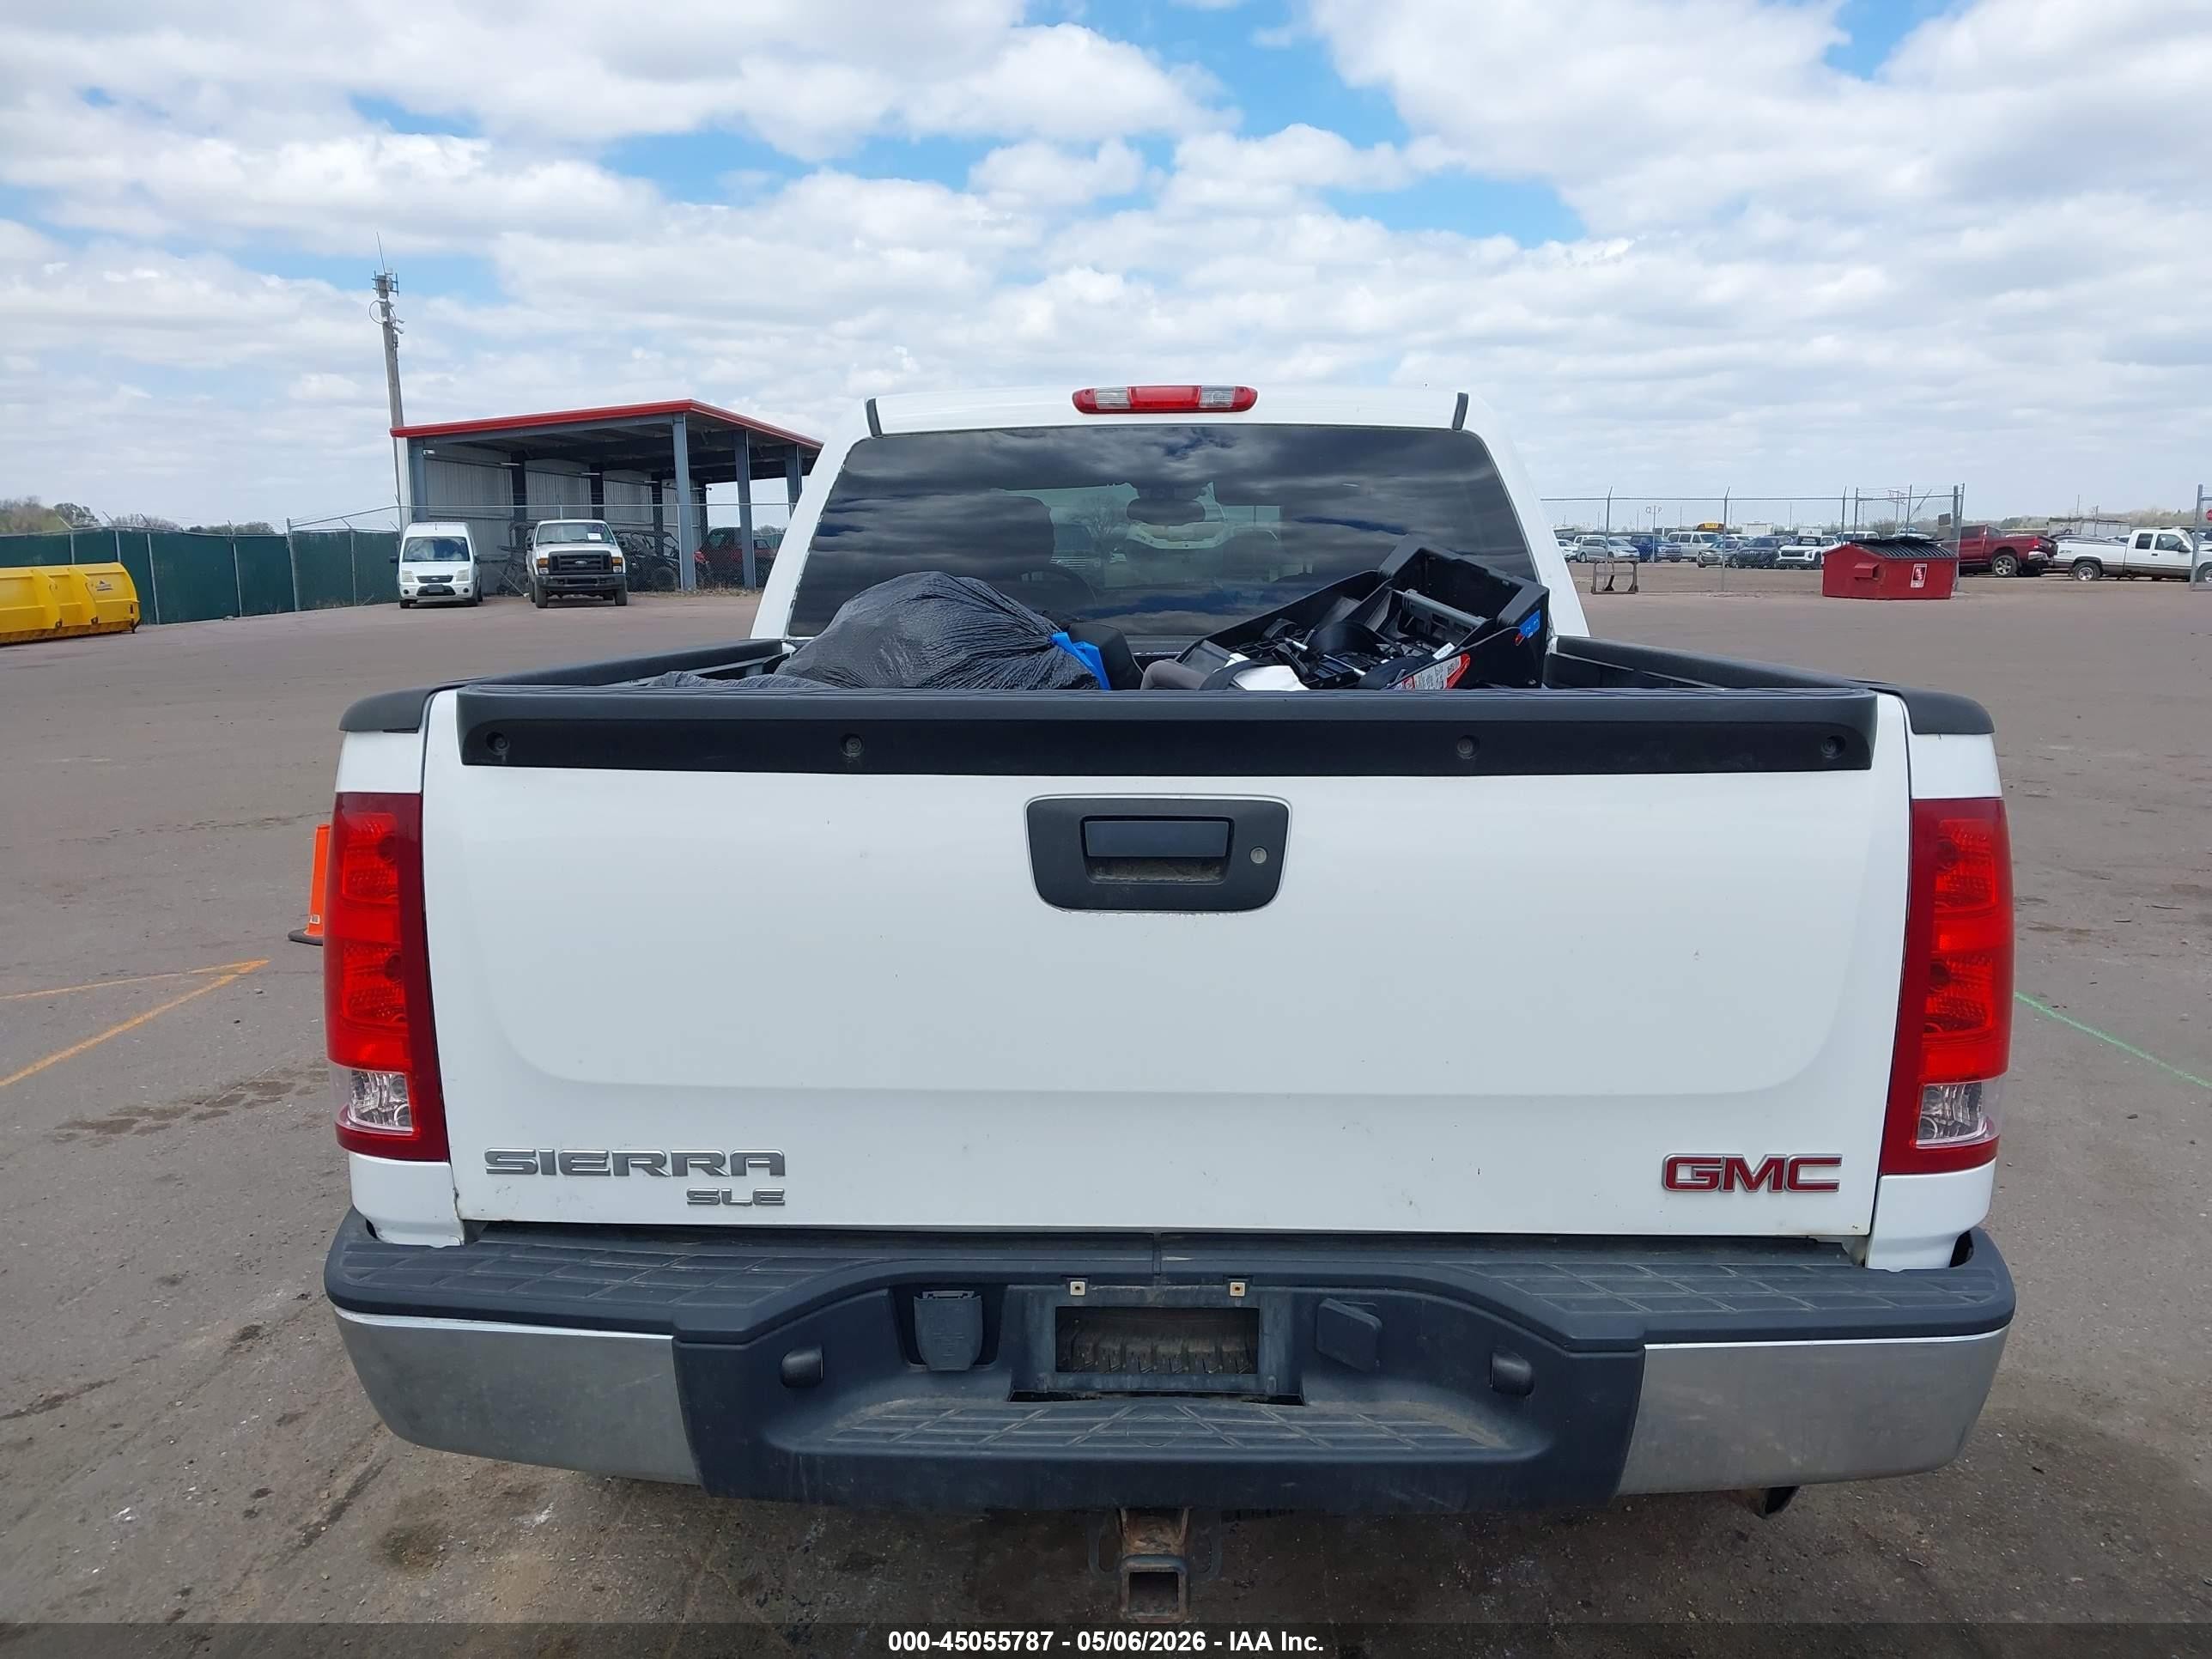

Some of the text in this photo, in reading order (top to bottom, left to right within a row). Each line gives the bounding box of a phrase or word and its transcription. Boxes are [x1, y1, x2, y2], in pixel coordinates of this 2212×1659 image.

[484, 1147, 786, 1176] SIERRA
[1662, 1153, 1843, 1193] GMC
[687, 1188, 785, 1206] SLE
